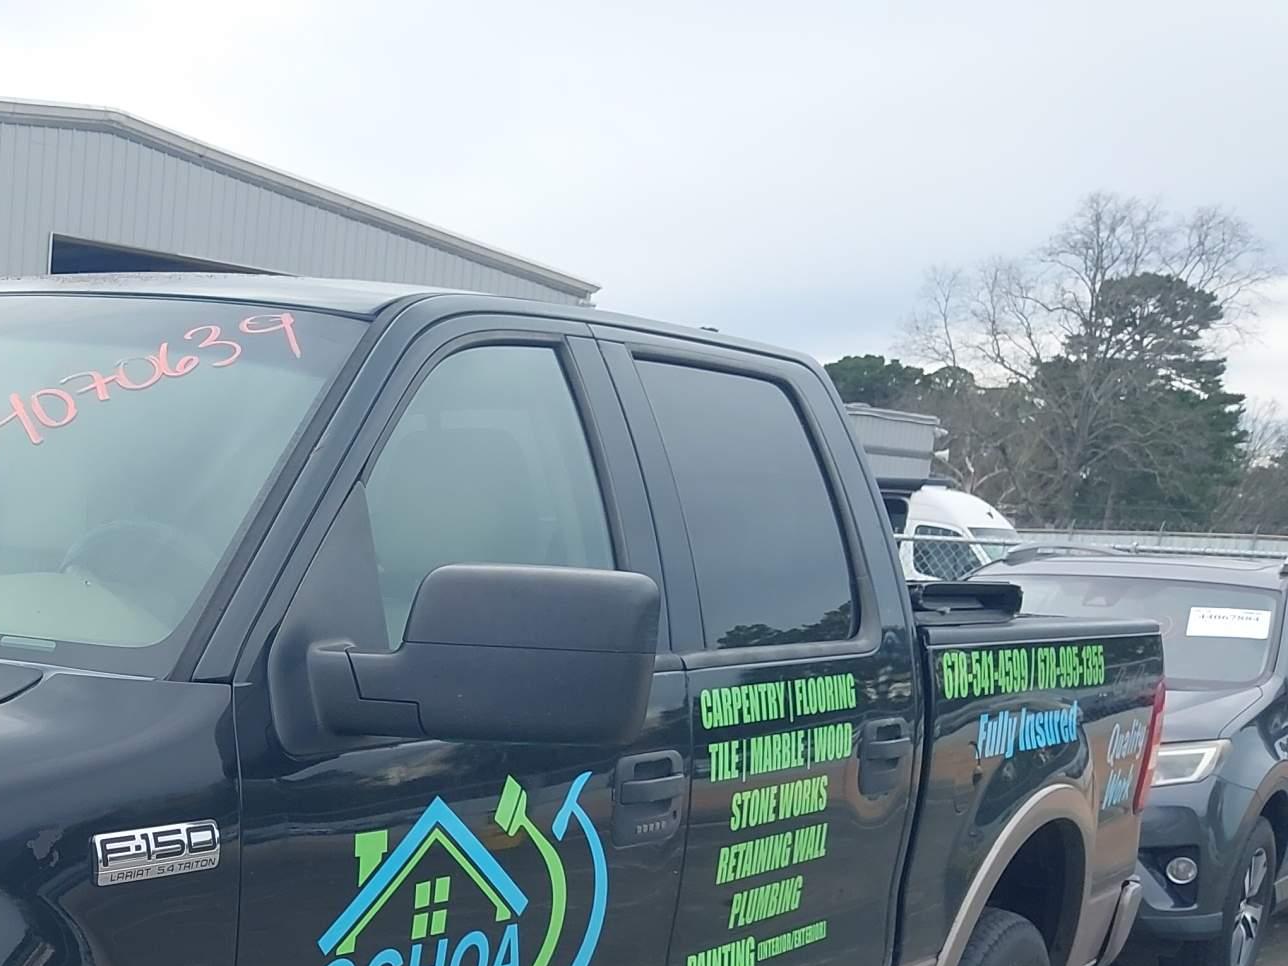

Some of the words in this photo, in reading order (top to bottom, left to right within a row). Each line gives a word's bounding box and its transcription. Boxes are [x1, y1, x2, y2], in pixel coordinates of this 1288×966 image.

[943, 648, 1029, 700] 678-541-4599
[1037, 645, 1105, 690] 678-995-1355
[700, 681, 785, 729] CARPENTRY
[794, 673, 856, 715] FLOORING
[709, 740, 740, 782] TILE
[750, 730, 805, 776] MARBLE
[813, 722, 853, 763] WOOD
[975, 711, 1018, 760] Fully
[1018, 700, 1078, 751] Insured
[730, 785, 778, 831] STONE
[779, 775, 828, 820] WORKS
[110, 868, 151, 882] LARIAT
[177, 857, 216, 871] TRITON
[716, 832, 792, 885] RETAINING
[793, 823, 828, 864] WALL
[728, 875, 803, 930] PLUMBING
